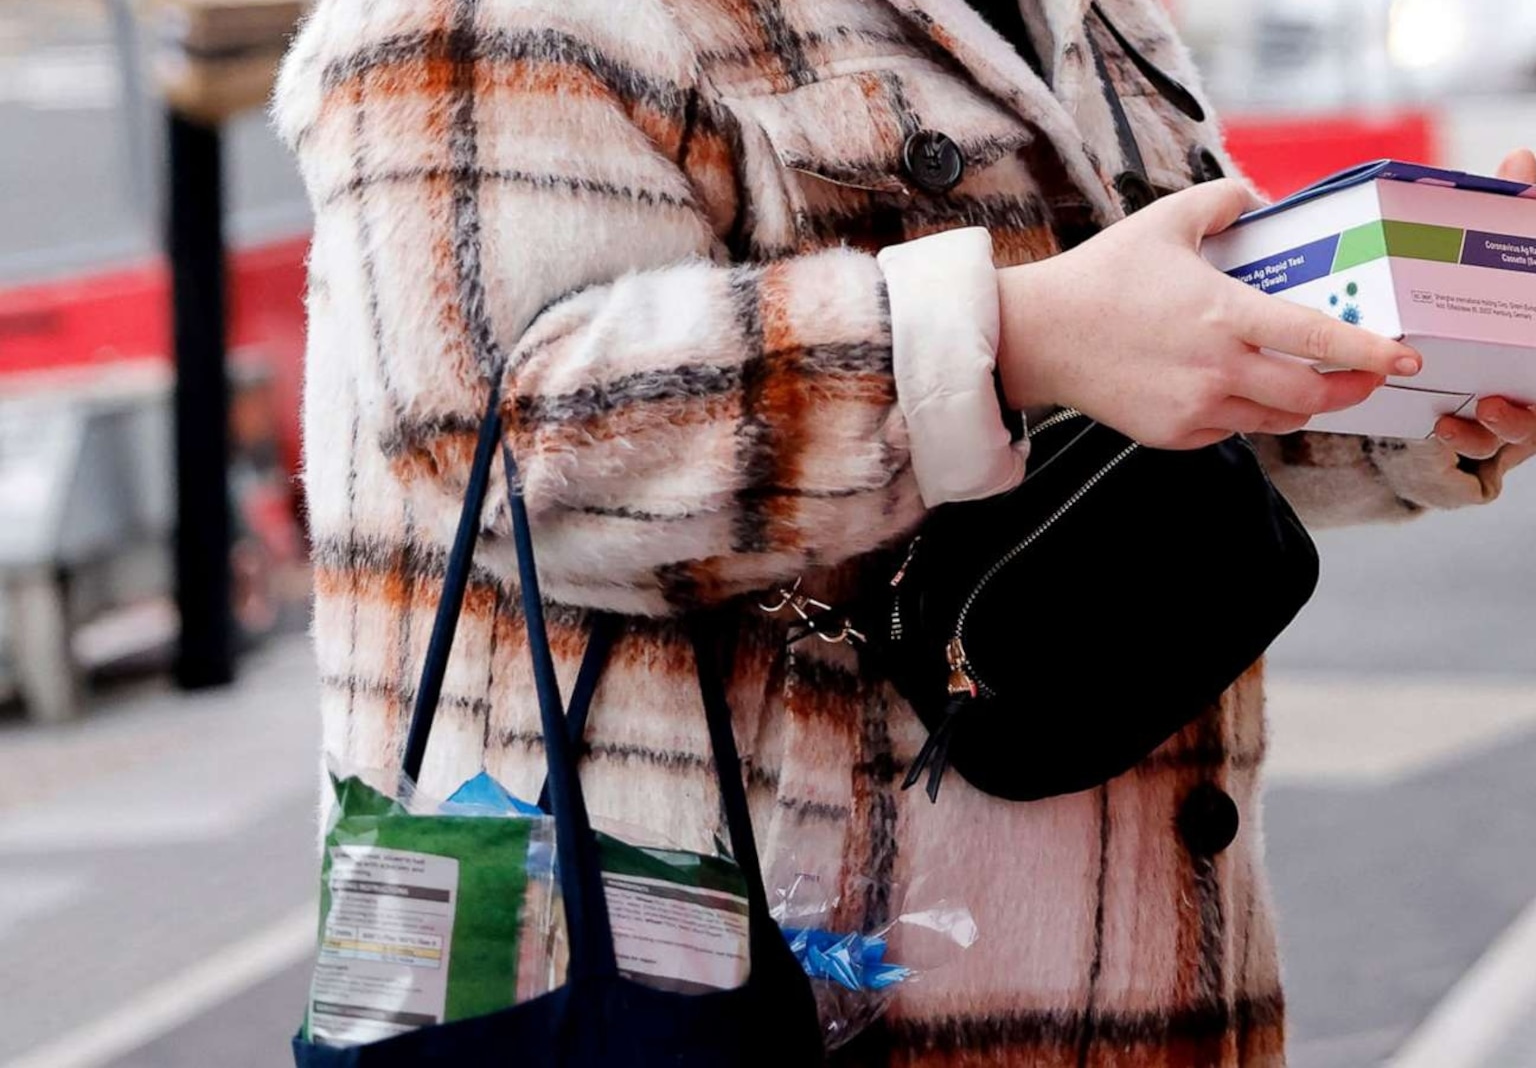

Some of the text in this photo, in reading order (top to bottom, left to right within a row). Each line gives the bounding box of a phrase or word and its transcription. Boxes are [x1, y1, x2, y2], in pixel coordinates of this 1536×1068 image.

[1253, 269, 1265, 281] Ag
[1264, 260, 1288, 276] Rapid
[1287, 255, 1305, 268] Test
[1261, 272, 1288, 290] (Swab)
